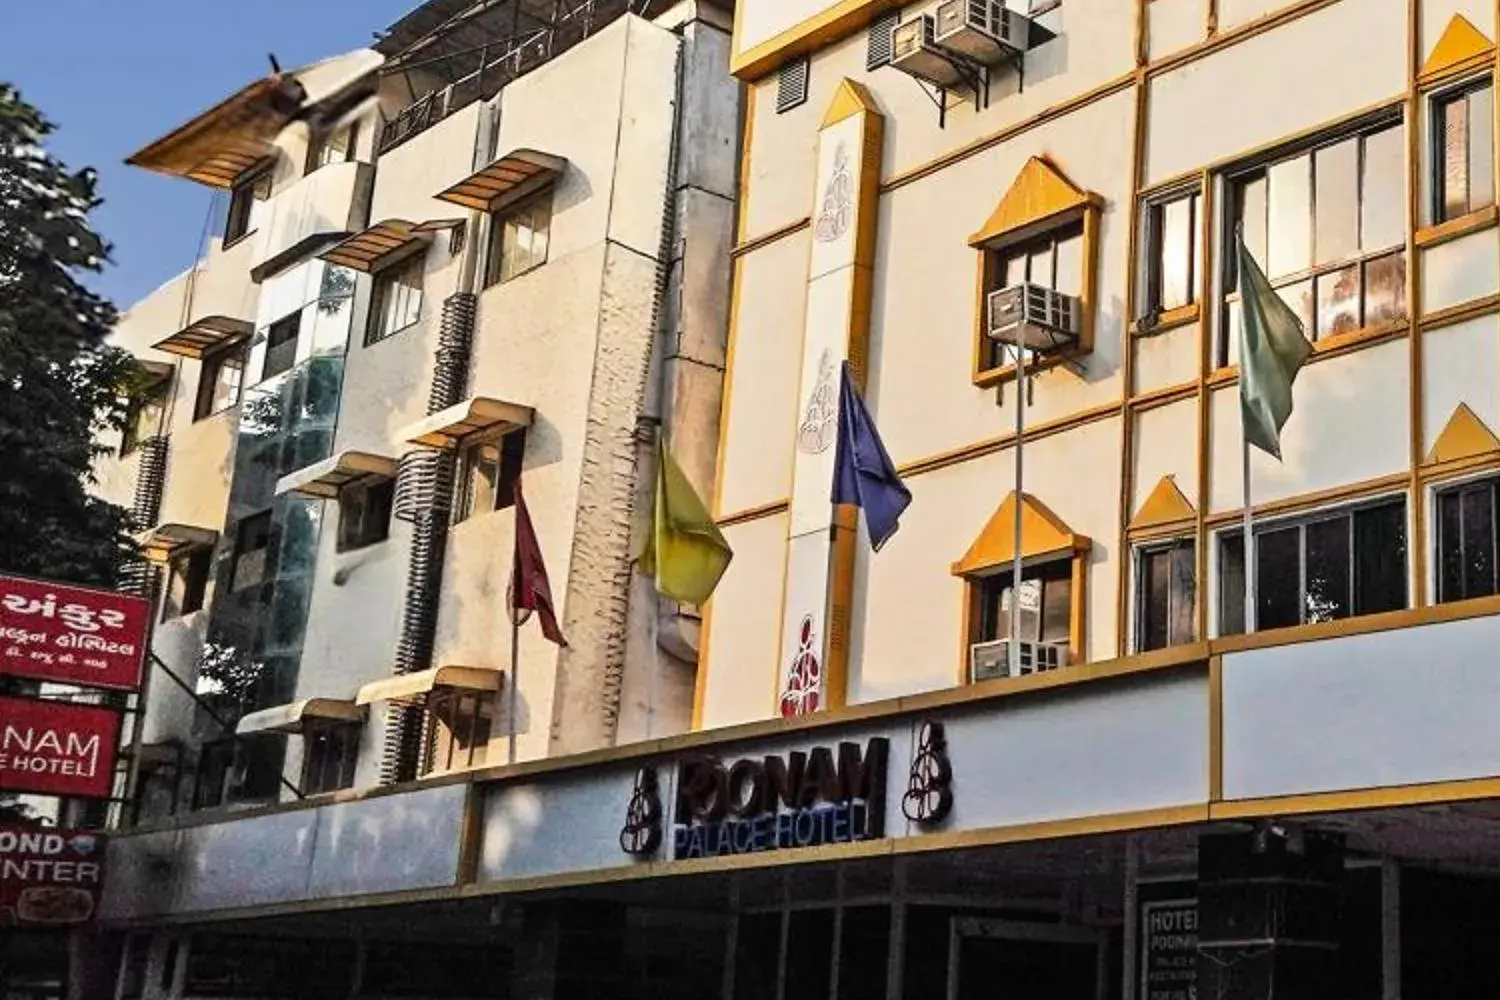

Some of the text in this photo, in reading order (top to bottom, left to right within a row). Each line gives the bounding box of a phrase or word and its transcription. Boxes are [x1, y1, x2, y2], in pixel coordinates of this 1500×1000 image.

[2, 593, 126, 631] અંકુર
[3, 725, 100, 778] NAM
[13, 755, 90, 777] HOTEL
[0, 831, 65, 855] OND
[673, 798, 869, 861] PALACE HOTEL
